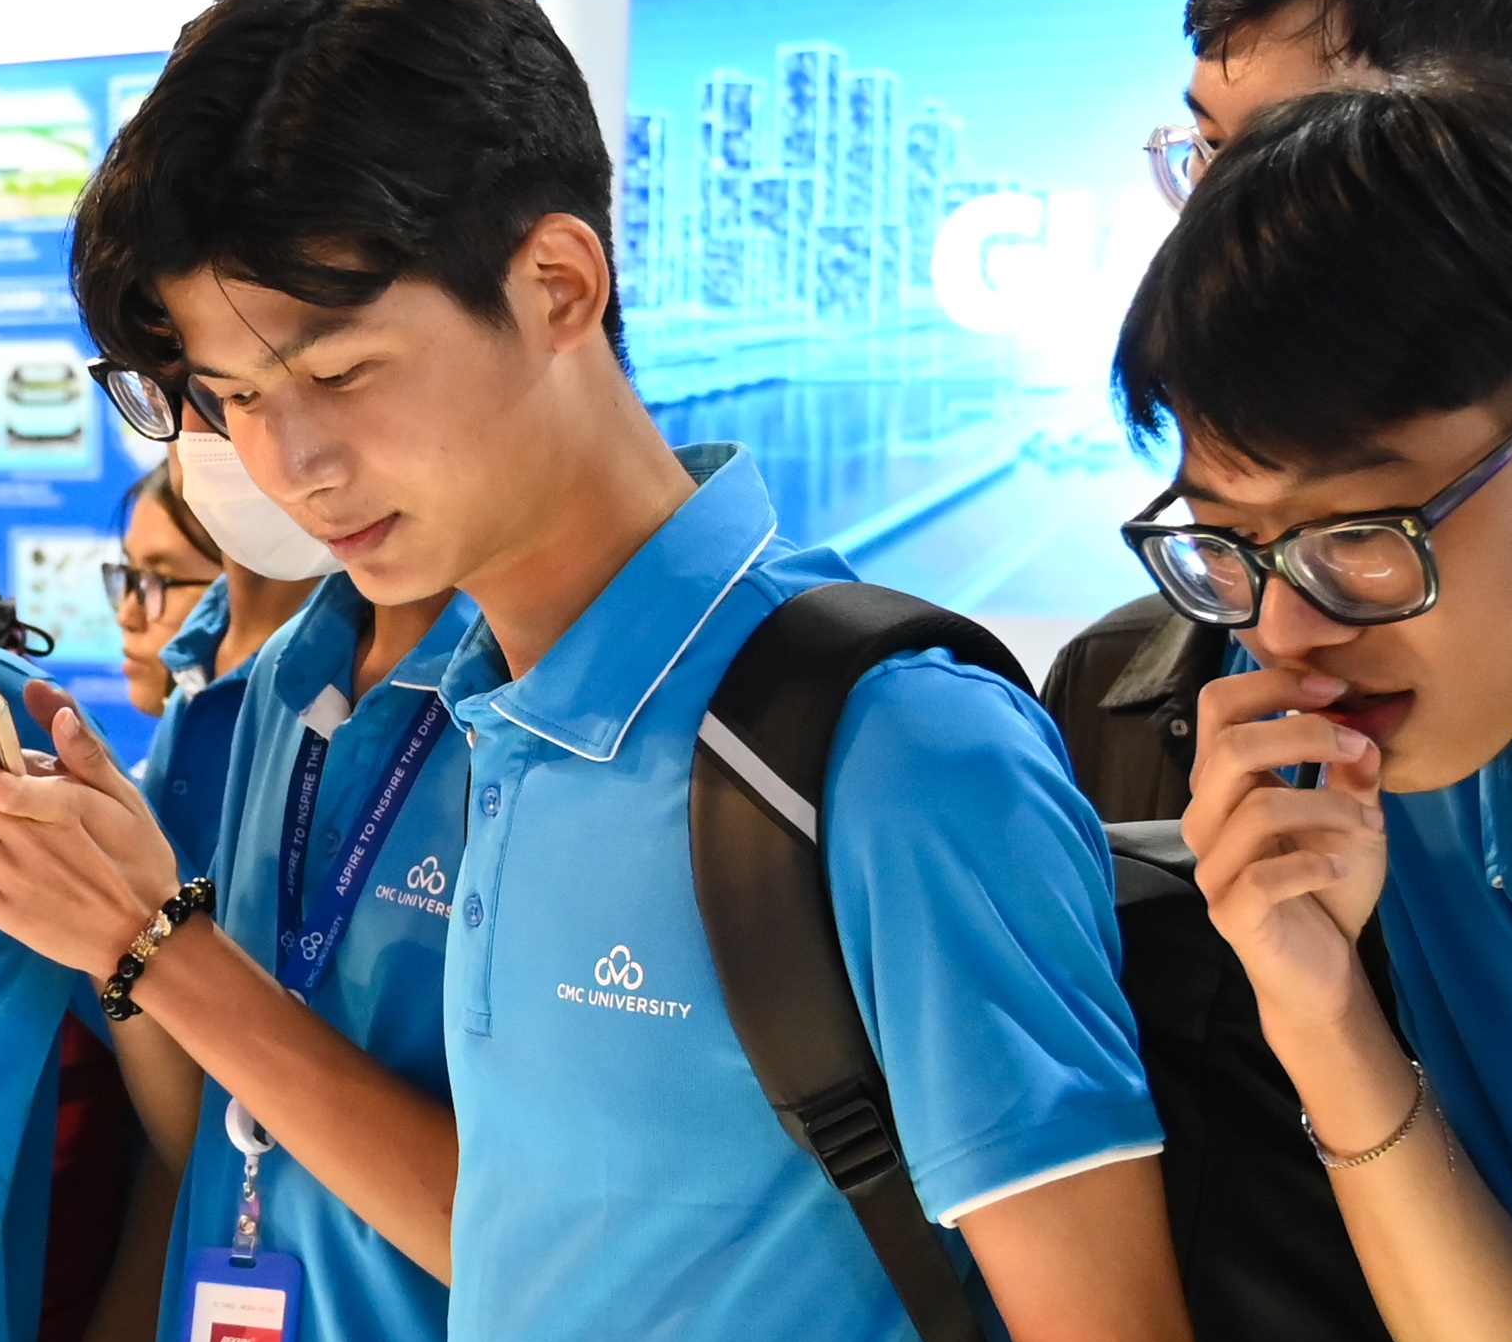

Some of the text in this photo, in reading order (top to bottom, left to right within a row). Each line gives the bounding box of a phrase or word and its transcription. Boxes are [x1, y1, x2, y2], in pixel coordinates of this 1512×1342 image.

[335, 845, 366, 898] ASPIRE
[358, 821, 377, 844] TO
[371, 764, 406, 822] INSPIRE
[400, 736, 423, 766] THE
[375, 884, 452, 920] CMC UNIVERS
[557, 982, 692, 1019] CMC UNIVERSITY
